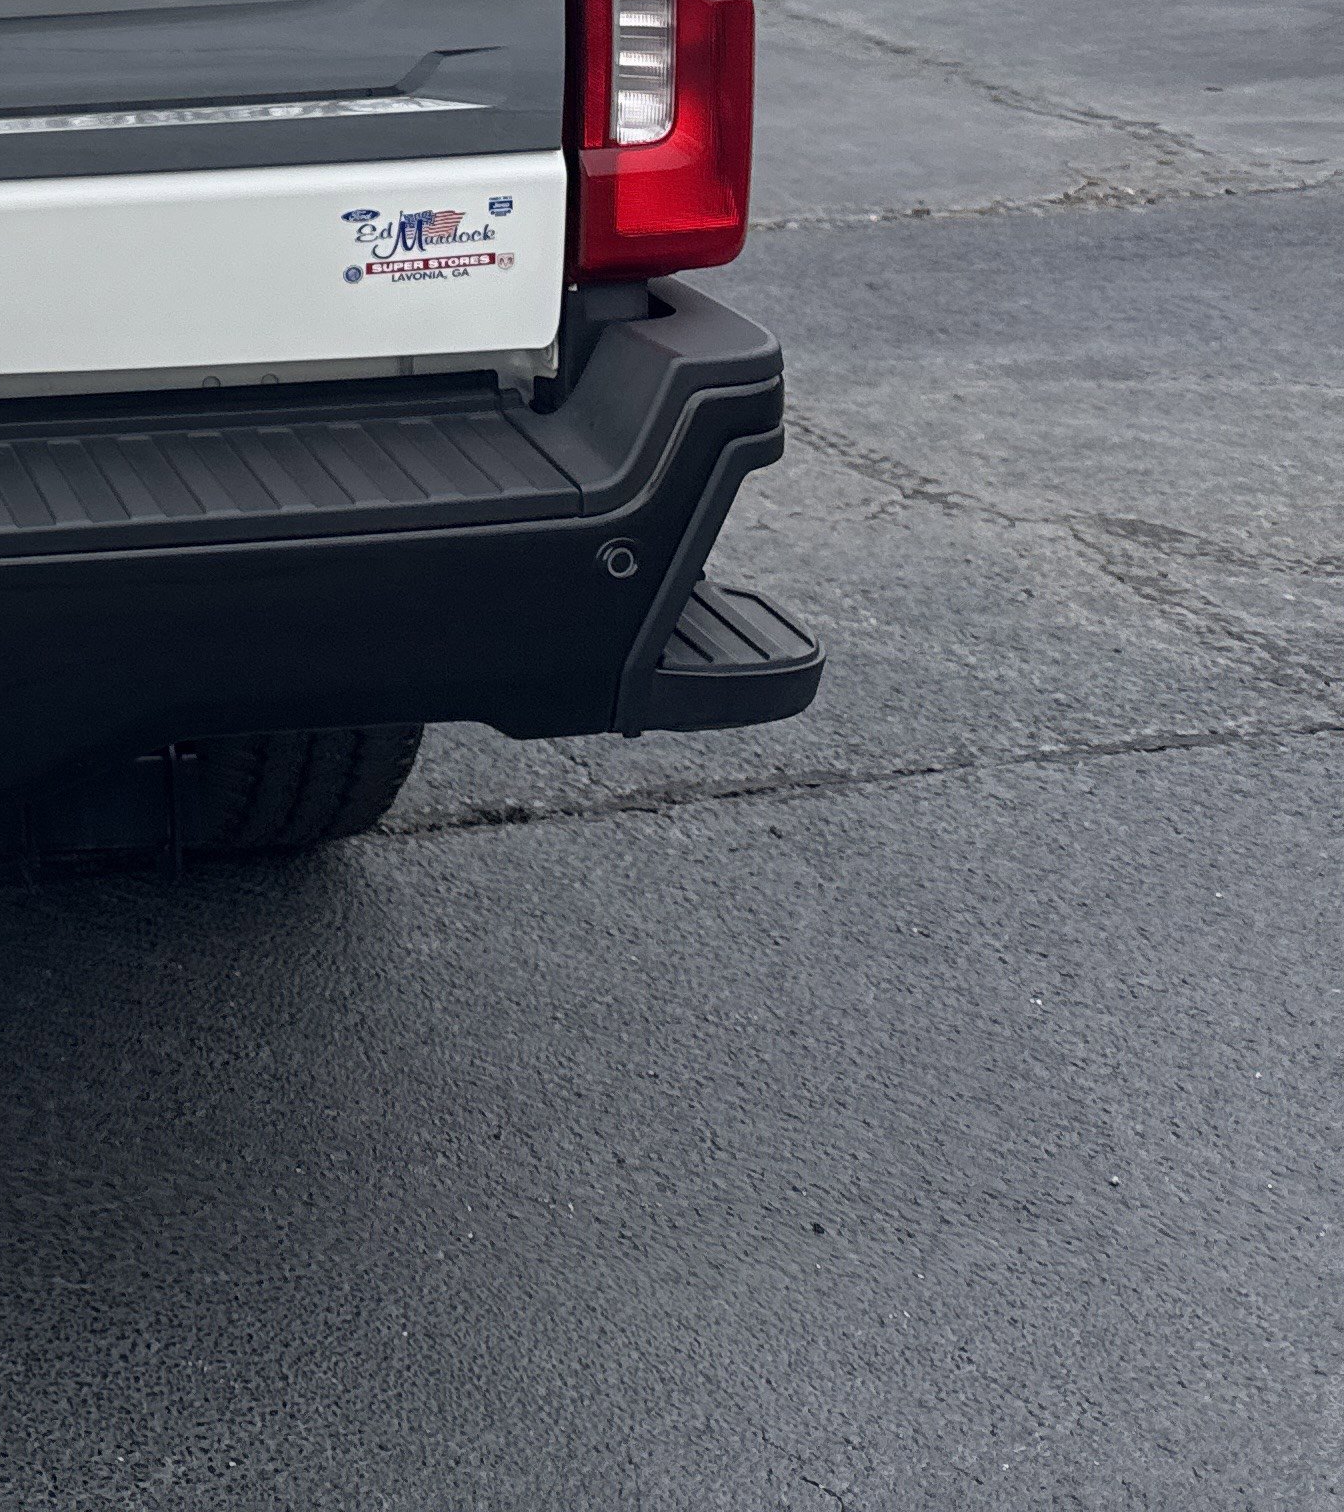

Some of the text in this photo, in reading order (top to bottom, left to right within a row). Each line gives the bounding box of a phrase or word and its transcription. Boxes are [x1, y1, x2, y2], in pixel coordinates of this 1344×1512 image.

[355, 219, 495, 259] Ed Murdock
[371, 254, 491, 273] SUPER STORES
[391, 268, 470, 283] LAVONIA, GA
